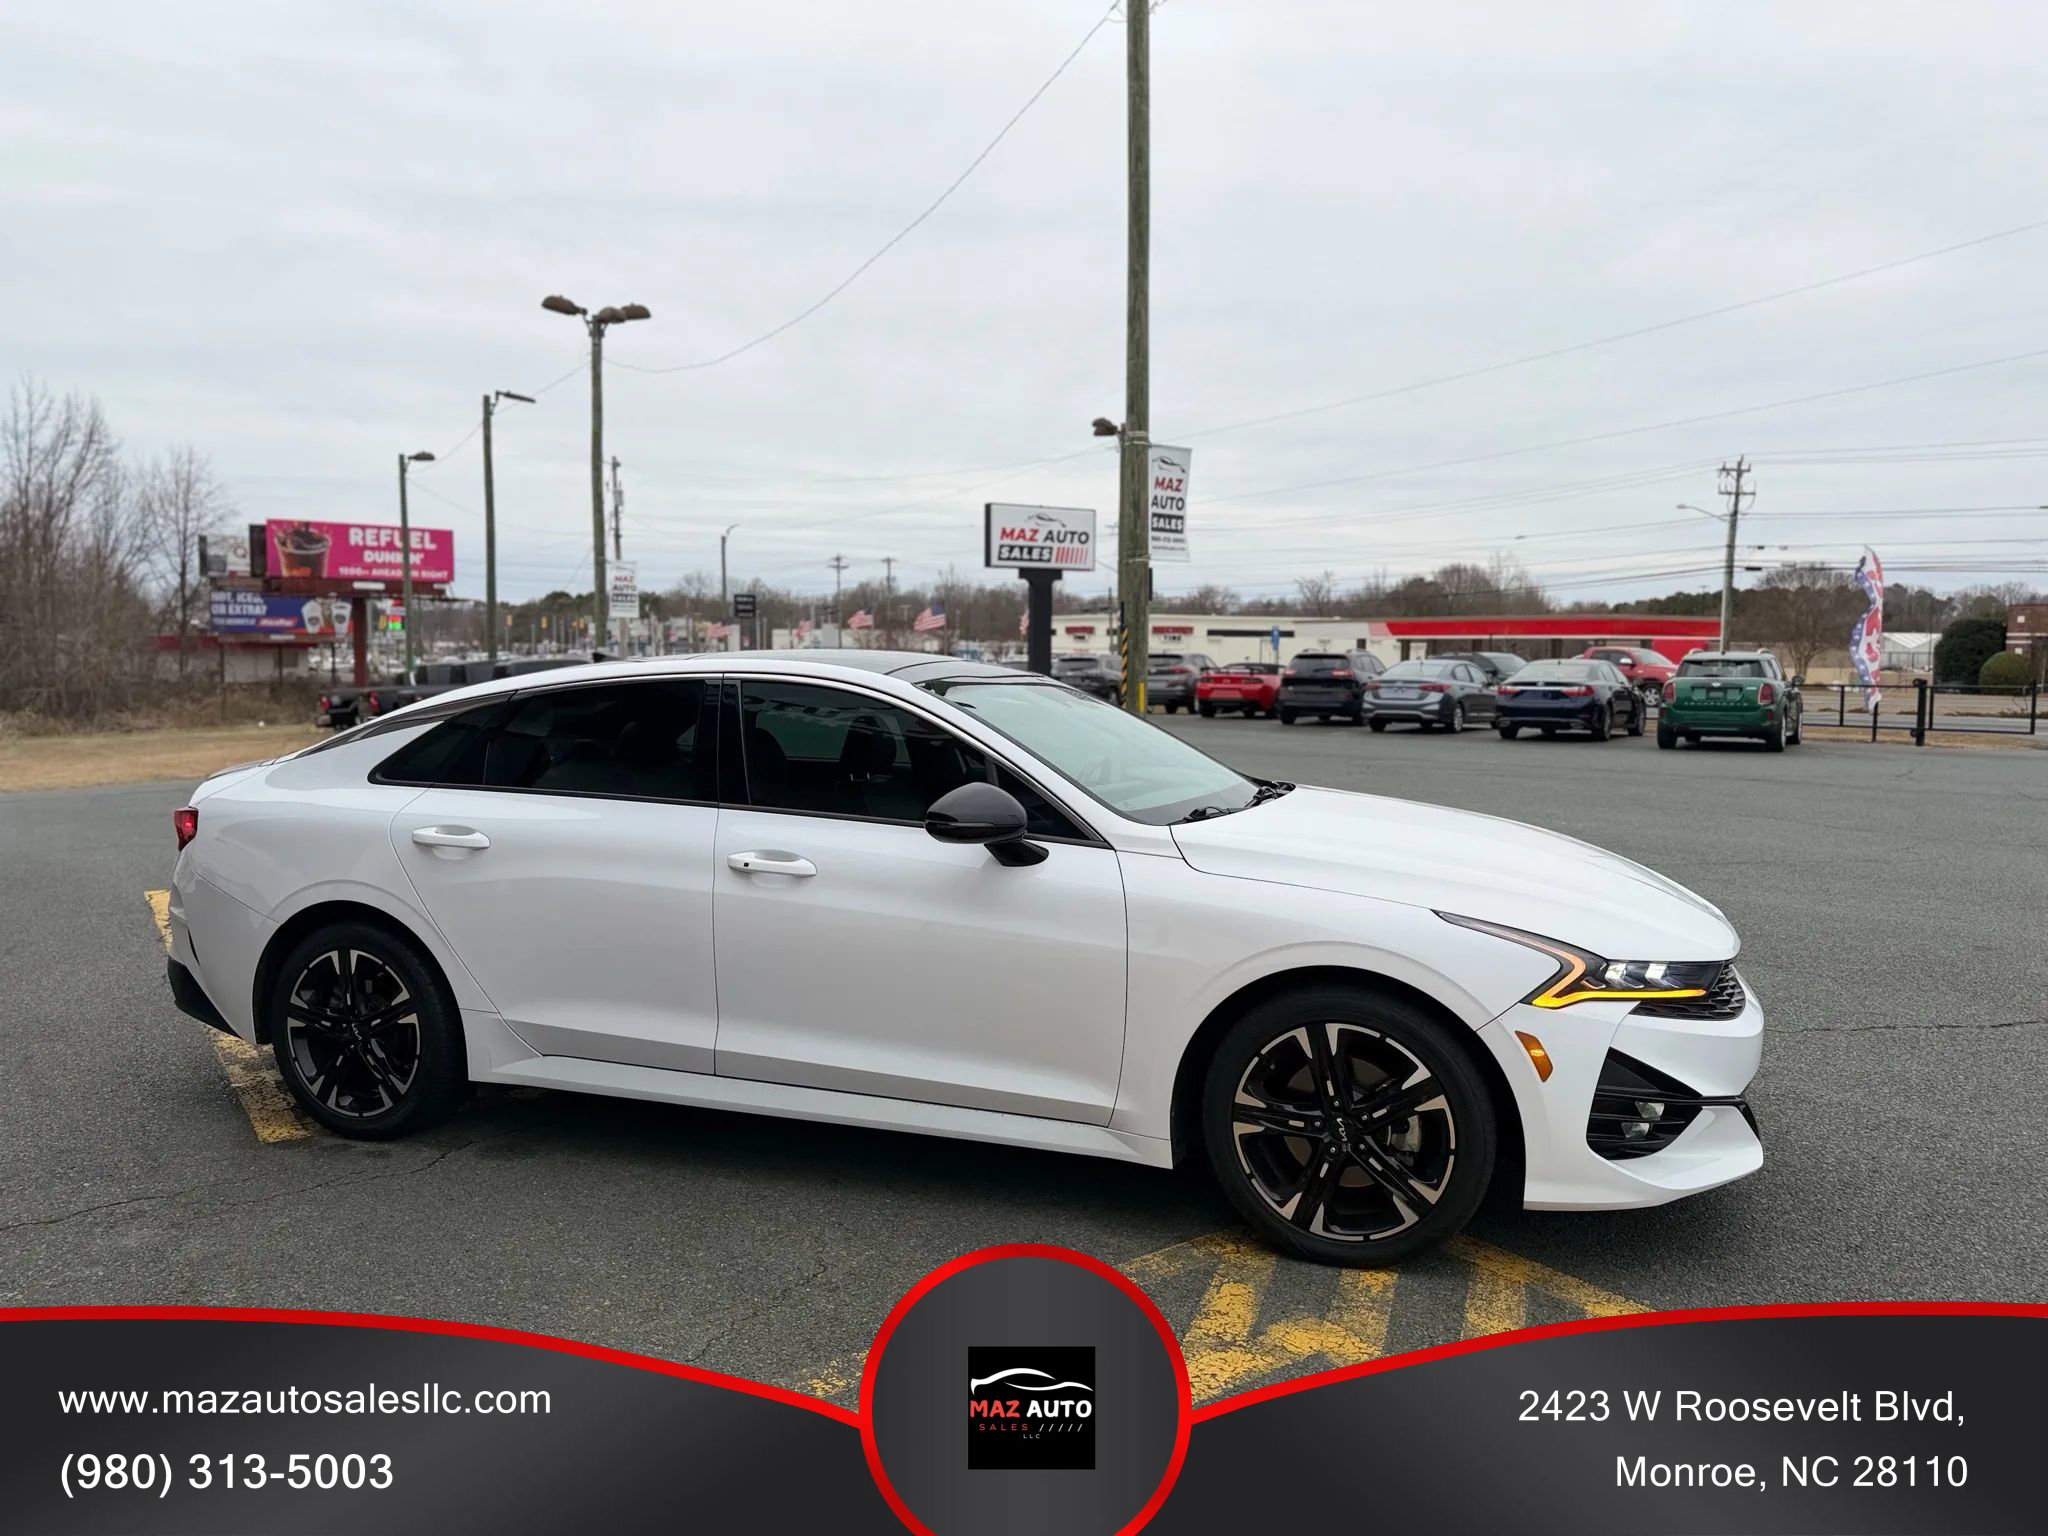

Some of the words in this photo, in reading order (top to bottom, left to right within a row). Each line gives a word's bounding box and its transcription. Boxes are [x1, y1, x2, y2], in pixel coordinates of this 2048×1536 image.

[1154, 476, 1184, 492] MAZ
[1151, 495, 1185, 511] AUTO
[1152, 516, 1183, 531] SALES
[348, 527, 437, 550] REFUEL
[999, 527, 1039, 543] MAZ
[1042, 530, 1090, 545] AUTO
[999, 547, 1051, 561] SALES
[612, 584, 637, 592] AUTO
